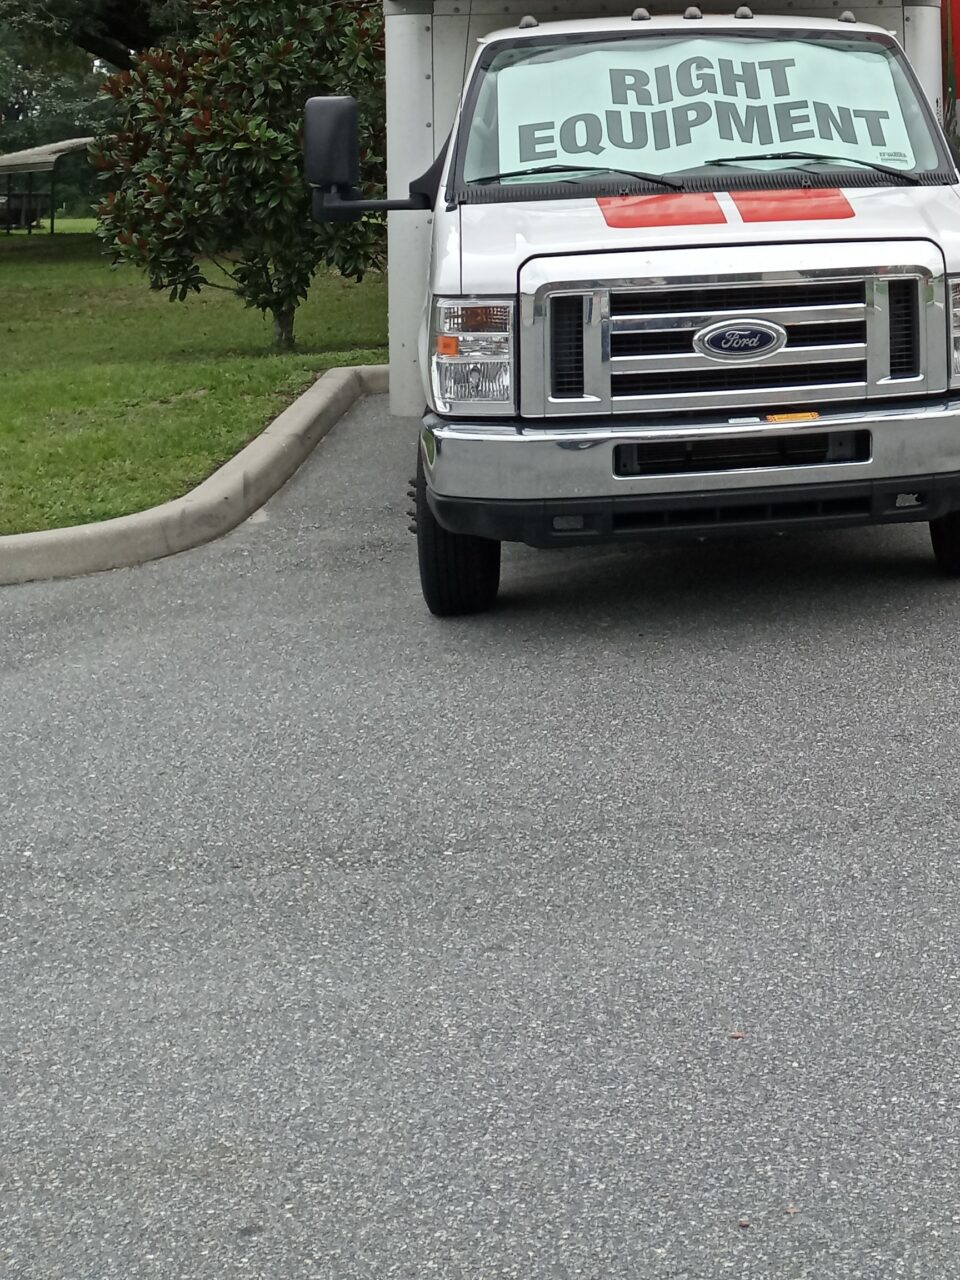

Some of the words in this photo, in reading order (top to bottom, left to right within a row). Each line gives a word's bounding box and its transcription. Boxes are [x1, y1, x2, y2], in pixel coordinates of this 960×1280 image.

[608, 55, 796, 106] RIGHT
[518, 100, 890, 163] EQUIPMENT
[721, 330, 761, 348] Ford
